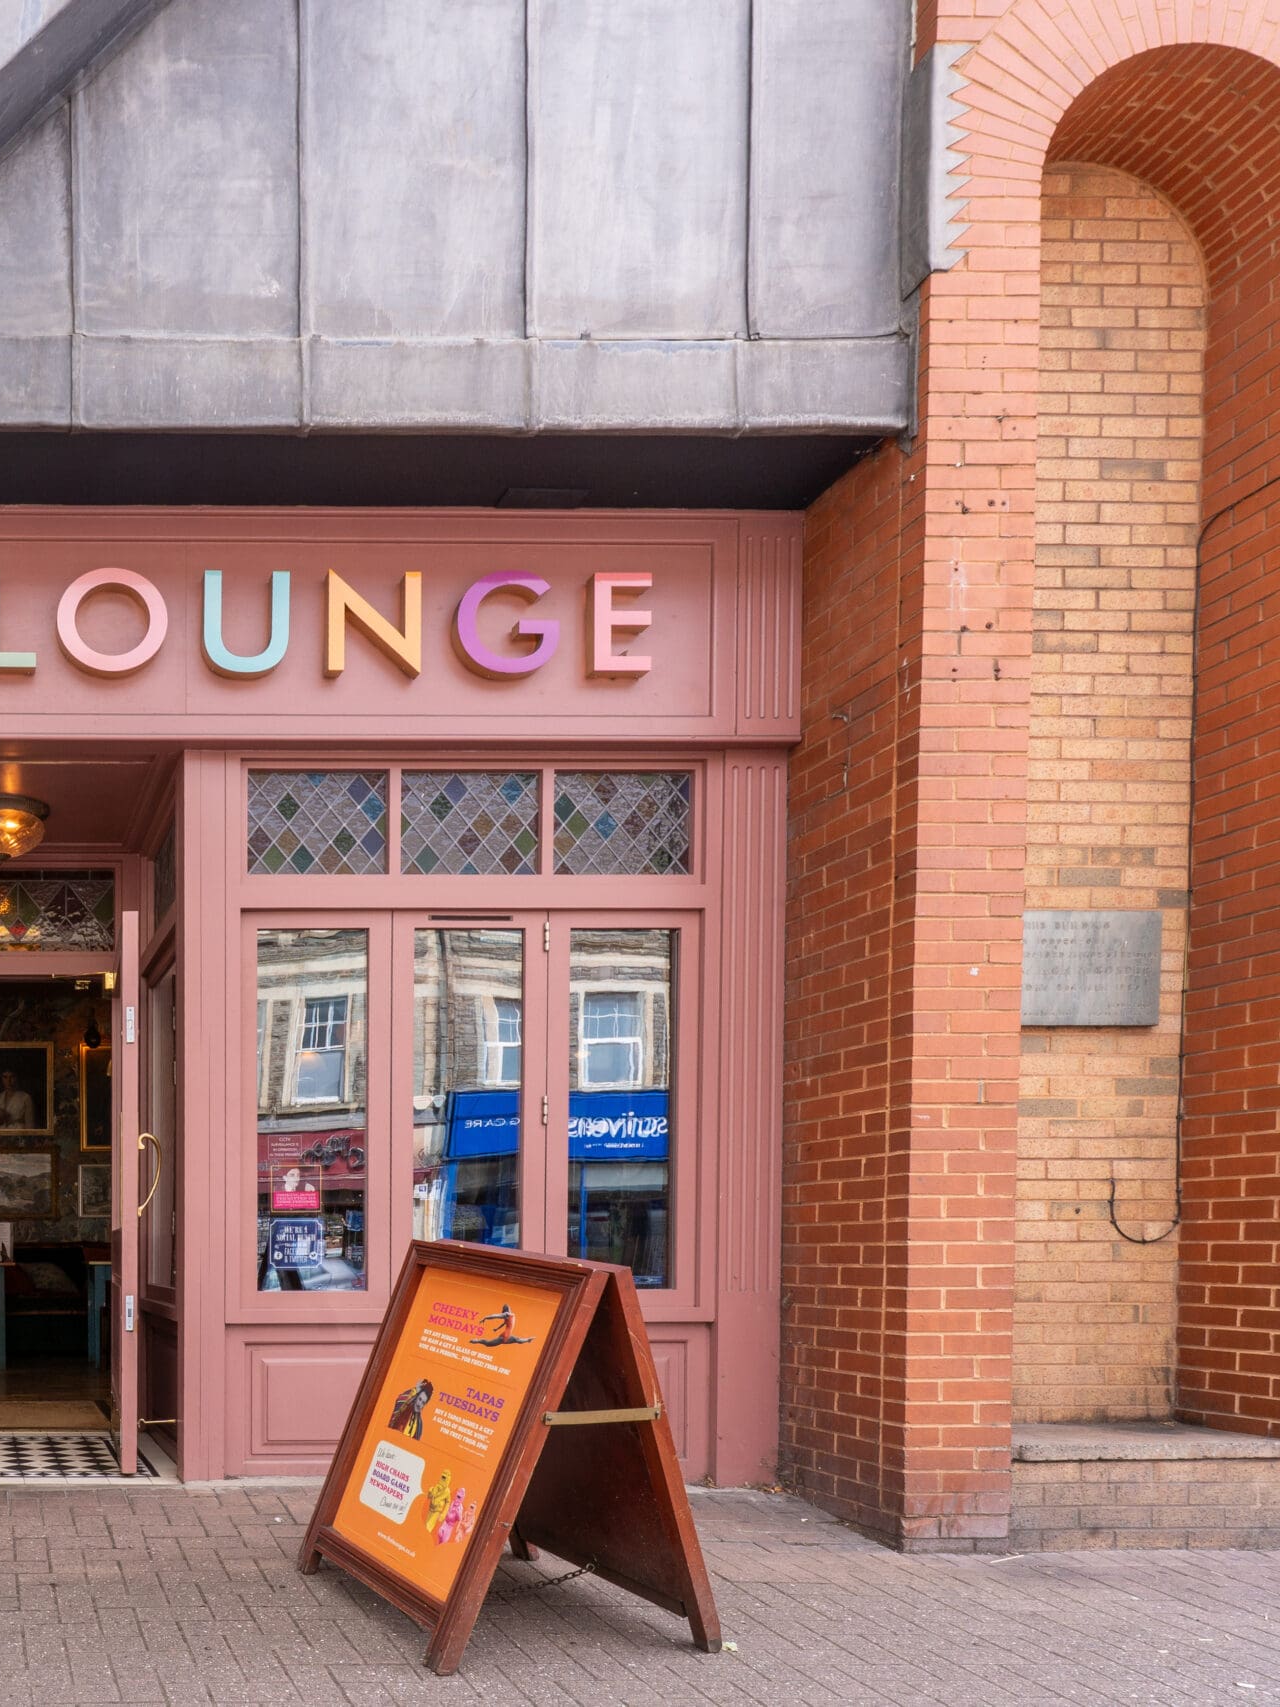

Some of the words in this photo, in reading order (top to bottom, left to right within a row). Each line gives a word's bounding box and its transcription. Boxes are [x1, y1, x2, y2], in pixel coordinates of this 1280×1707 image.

[433, 1302, 479, 1321] CHEEKY
[428, 1314, 485, 1337] MONDAYS
[439, 1392, 500, 1422] TUESDAYS
[466, 1387, 505, 1409] TAPAS
[372, 1469, 390, 1483] BOARD
[391, 1478, 410, 1494] GAMES
[376, 1460, 389, 1472] HIGH
[389, 1467, 410, 1482] CHAIRS
[369, 1477, 404, 1501] NEWSPAPERS
